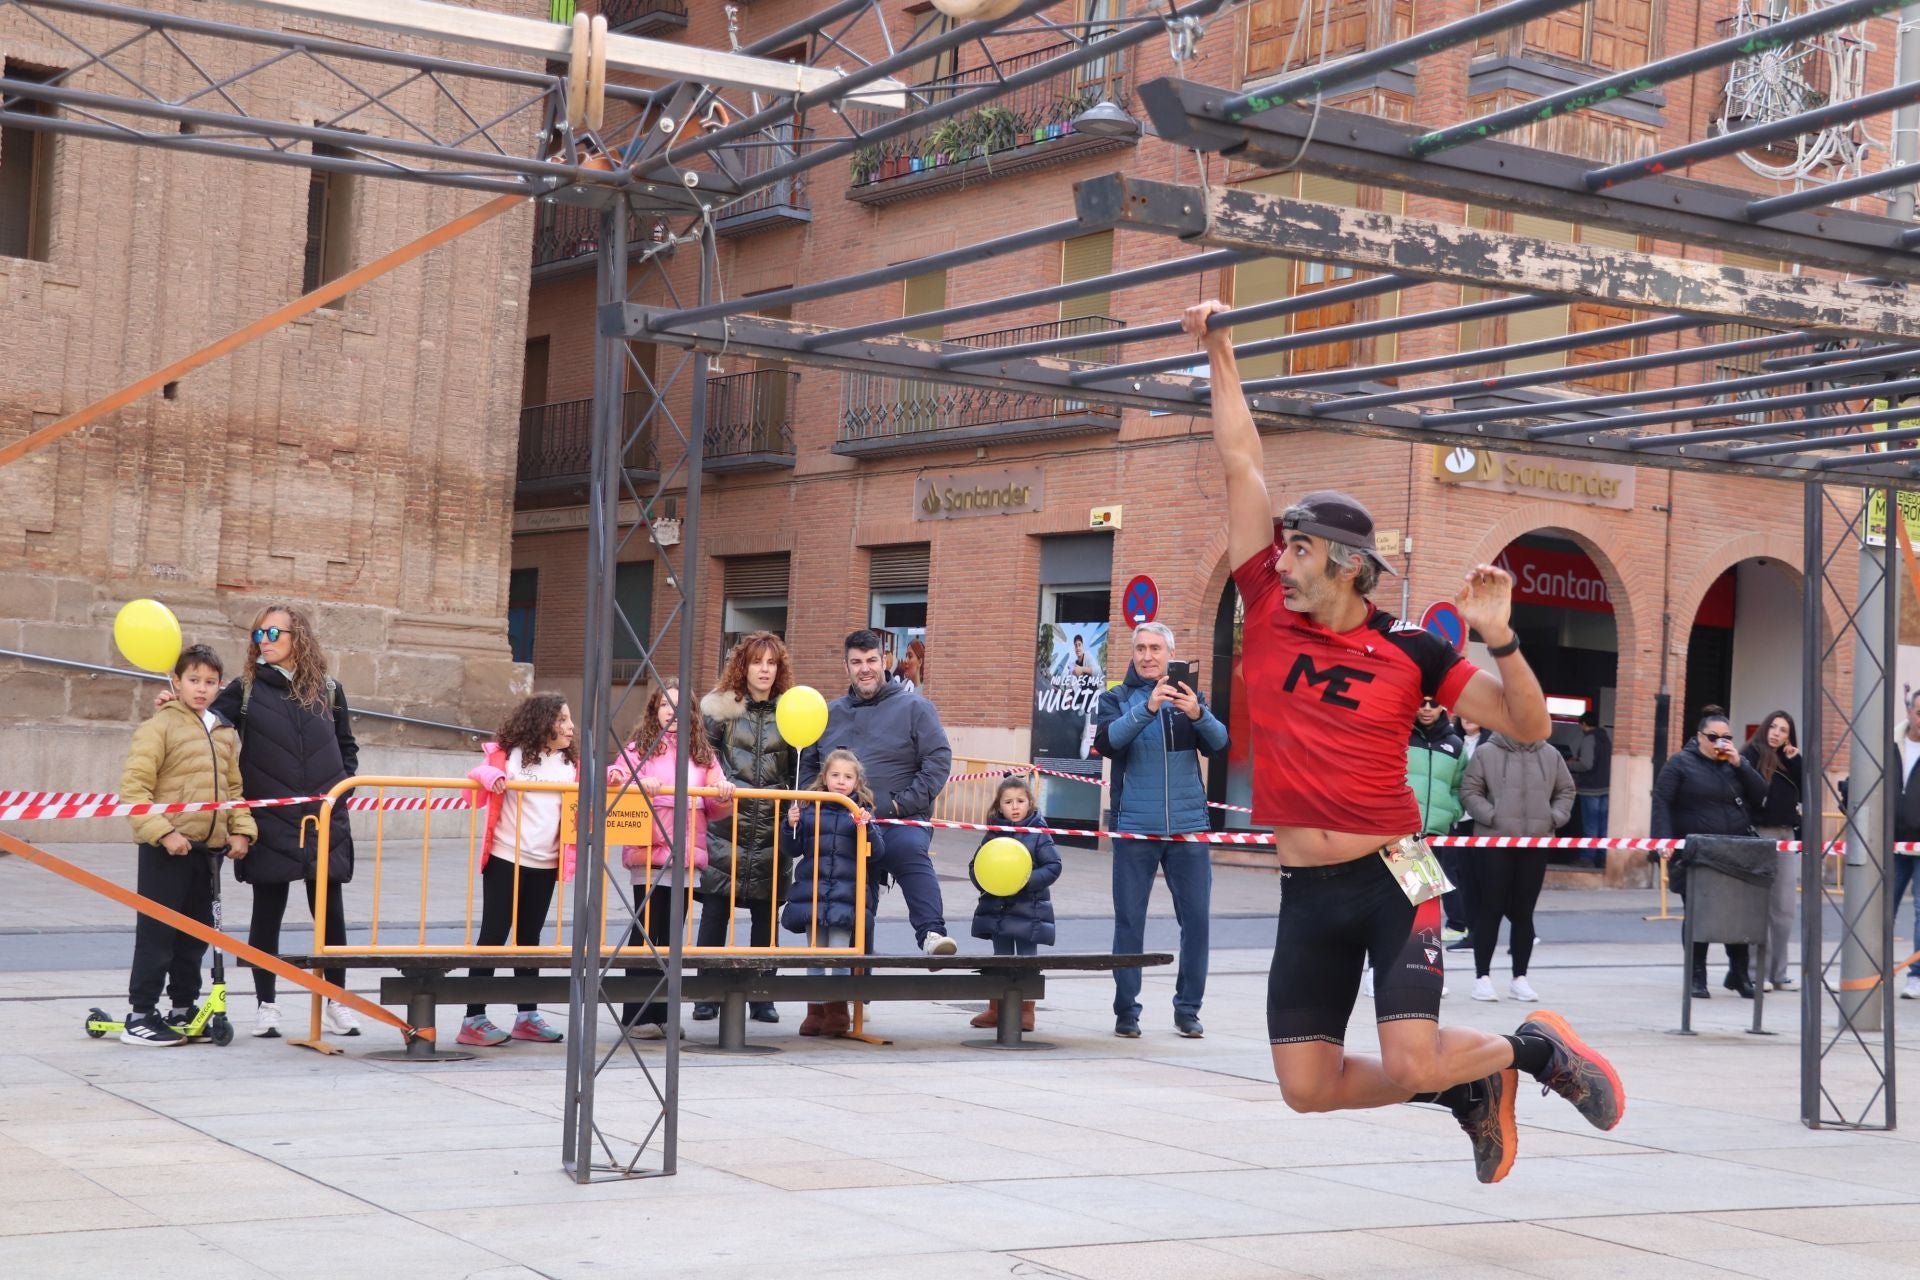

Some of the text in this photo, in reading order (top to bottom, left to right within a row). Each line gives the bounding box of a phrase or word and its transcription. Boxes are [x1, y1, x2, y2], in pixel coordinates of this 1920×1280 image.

[1504, 456, 1622, 497] Santander
[944, 482, 1032, 511] Santander
[1051, 673, 1105, 687] NO LE DES MÁS
[1281, 652, 1376, 711] ME
[1038, 688, 1100, 714] VUELTA
